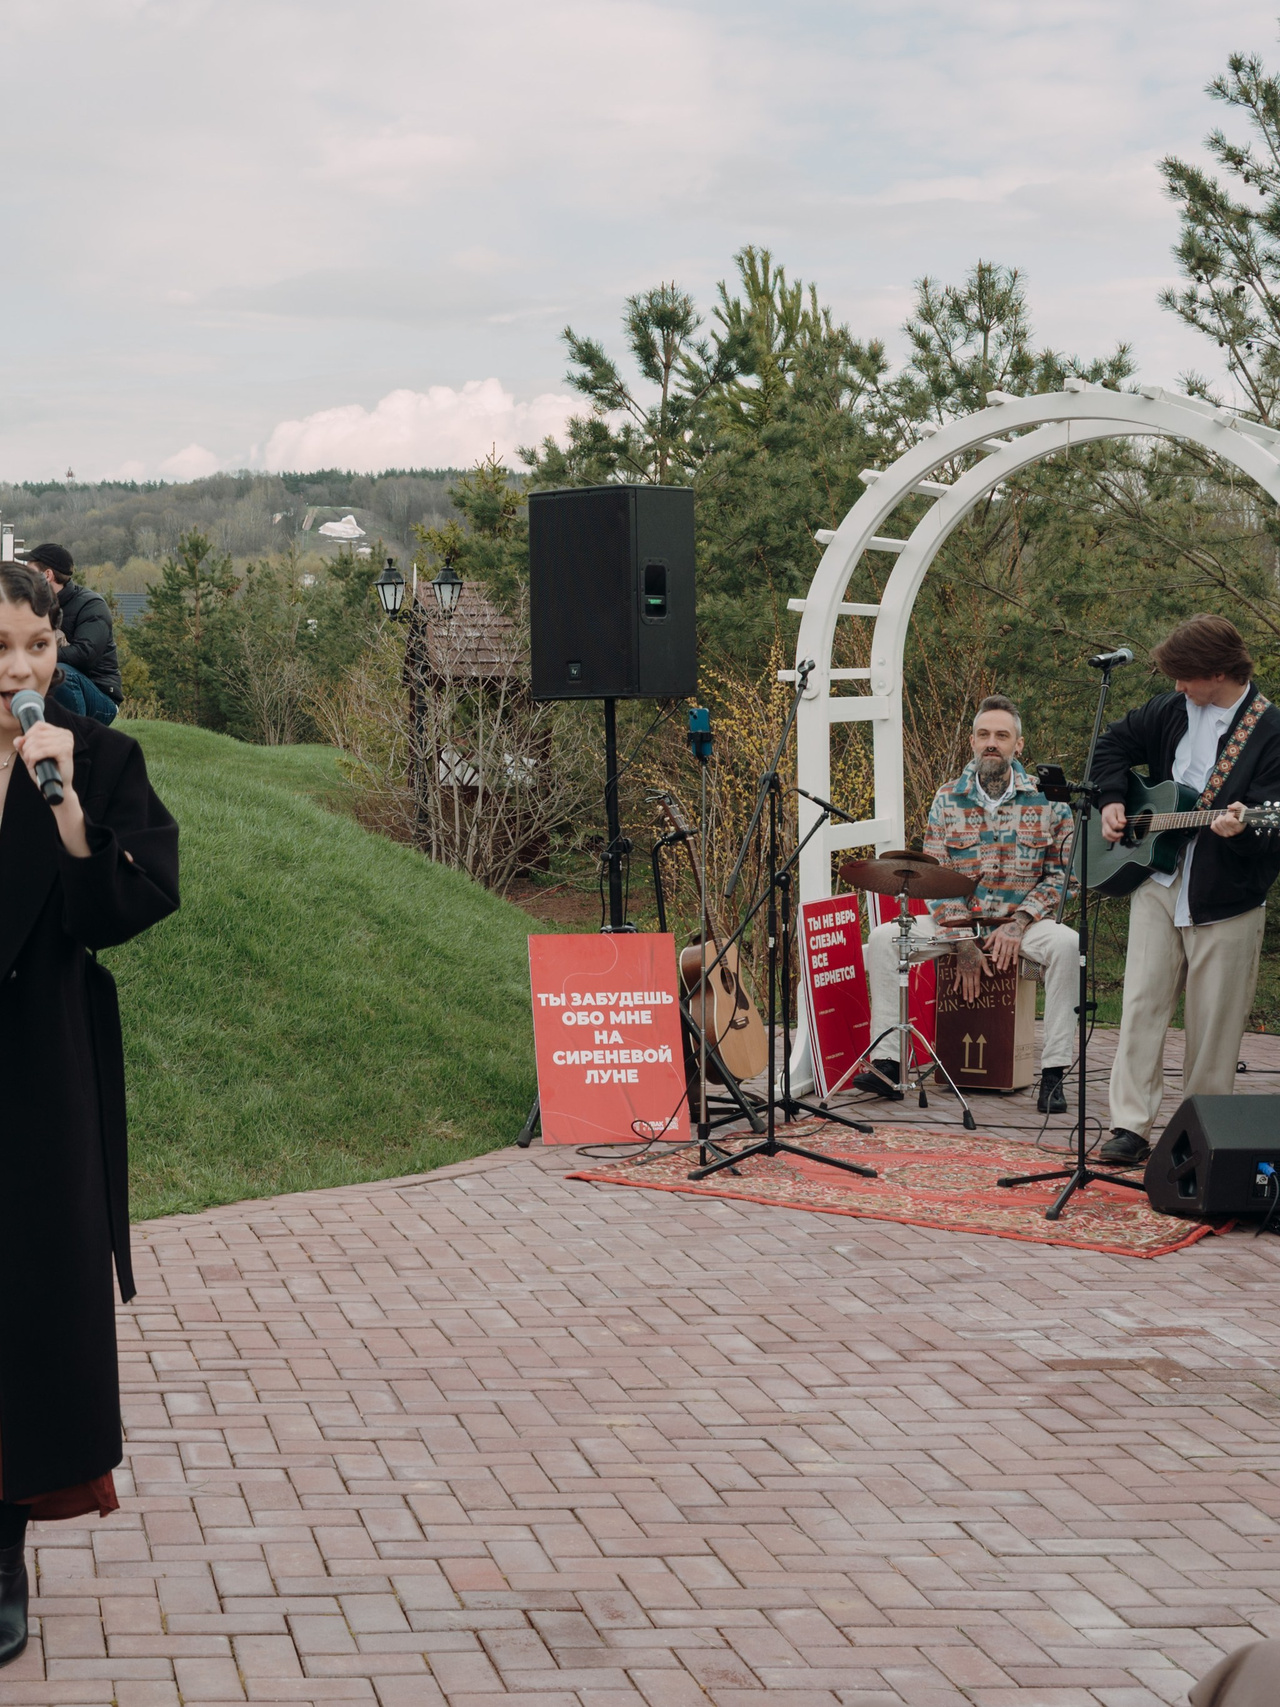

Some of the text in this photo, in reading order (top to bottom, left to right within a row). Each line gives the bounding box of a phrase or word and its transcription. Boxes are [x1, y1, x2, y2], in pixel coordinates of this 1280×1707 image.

[807, 909, 856, 931] ТЫ НЕ ВЕРЬ
[810, 930, 846, 950] СЛЕЗАМ,
[811, 952, 829, 969] ВСЕ
[813, 965, 856, 988] ВЕРНЕТСЯ
[537, 991, 674, 1007] ТЫ ЗАБУДЕШЬ
[562, 1010, 652, 1026] ОБО МНЕ
[594, 1030, 624, 1045] НА
[552, 1044, 673, 1065] СИРЕНЕВОЙ
[585, 1069, 639, 1084] ЛУНЕ
